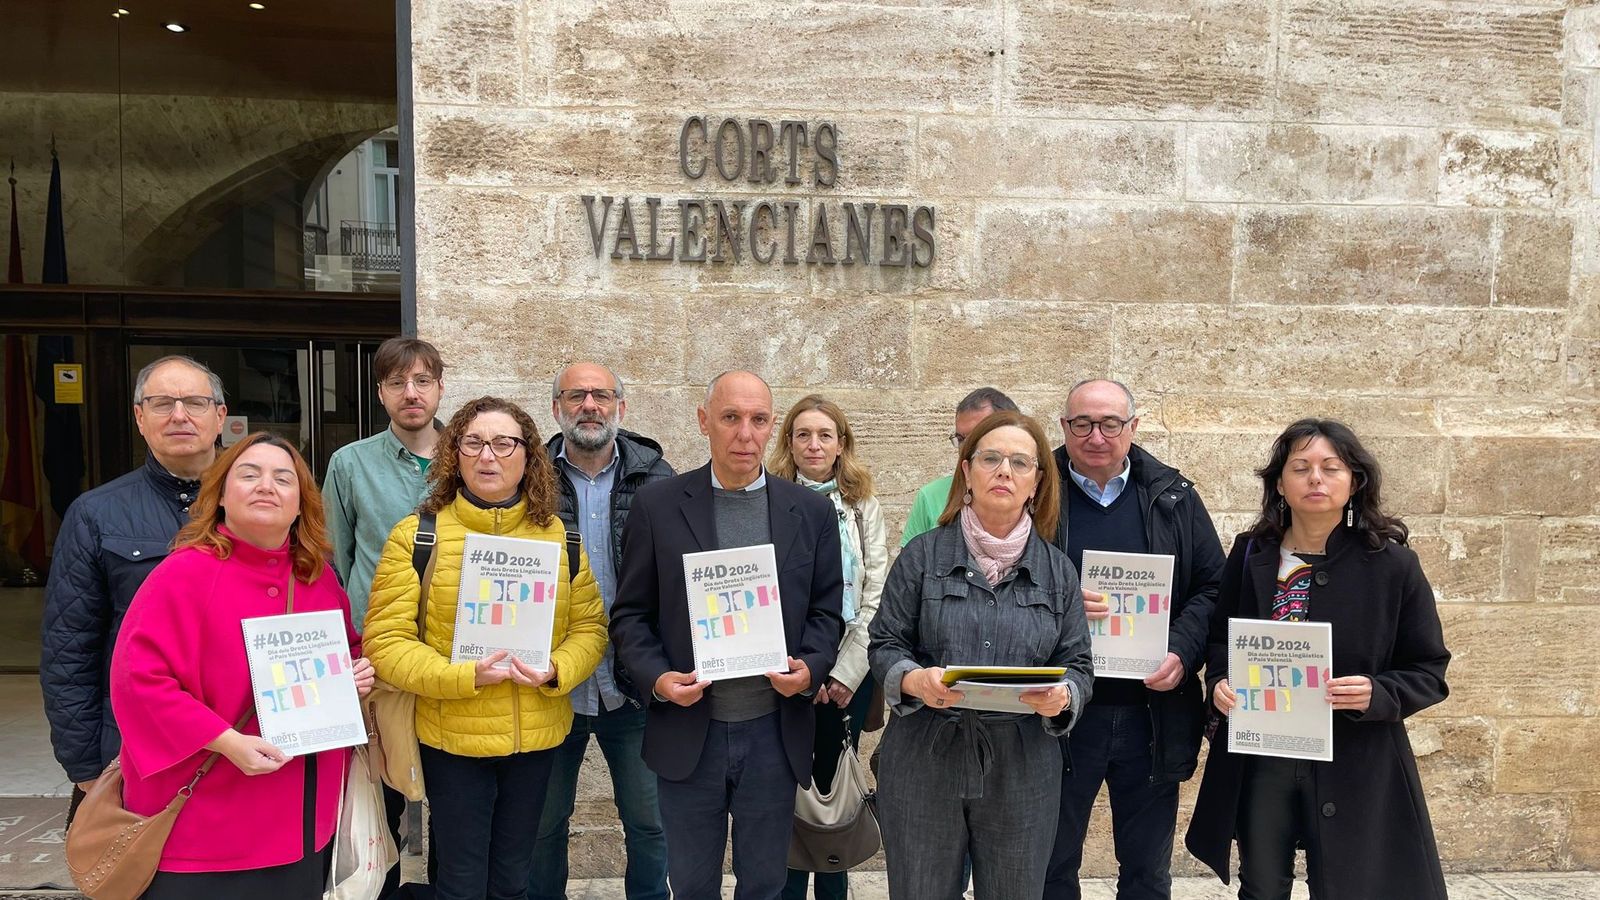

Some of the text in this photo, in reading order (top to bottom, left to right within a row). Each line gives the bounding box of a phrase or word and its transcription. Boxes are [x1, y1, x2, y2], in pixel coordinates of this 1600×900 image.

[679, 115, 838, 188] CORTS
[580, 194, 936, 268] VALENCIANES
[469, 550, 541, 567] #4D 2024
[692, 563, 759, 582] #4D 2024
[1088, 565, 1155, 580] #4D 2024
[253, 629, 328, 650] #4D 2024
[1235, 635, 1311, 651] #4D 2024
